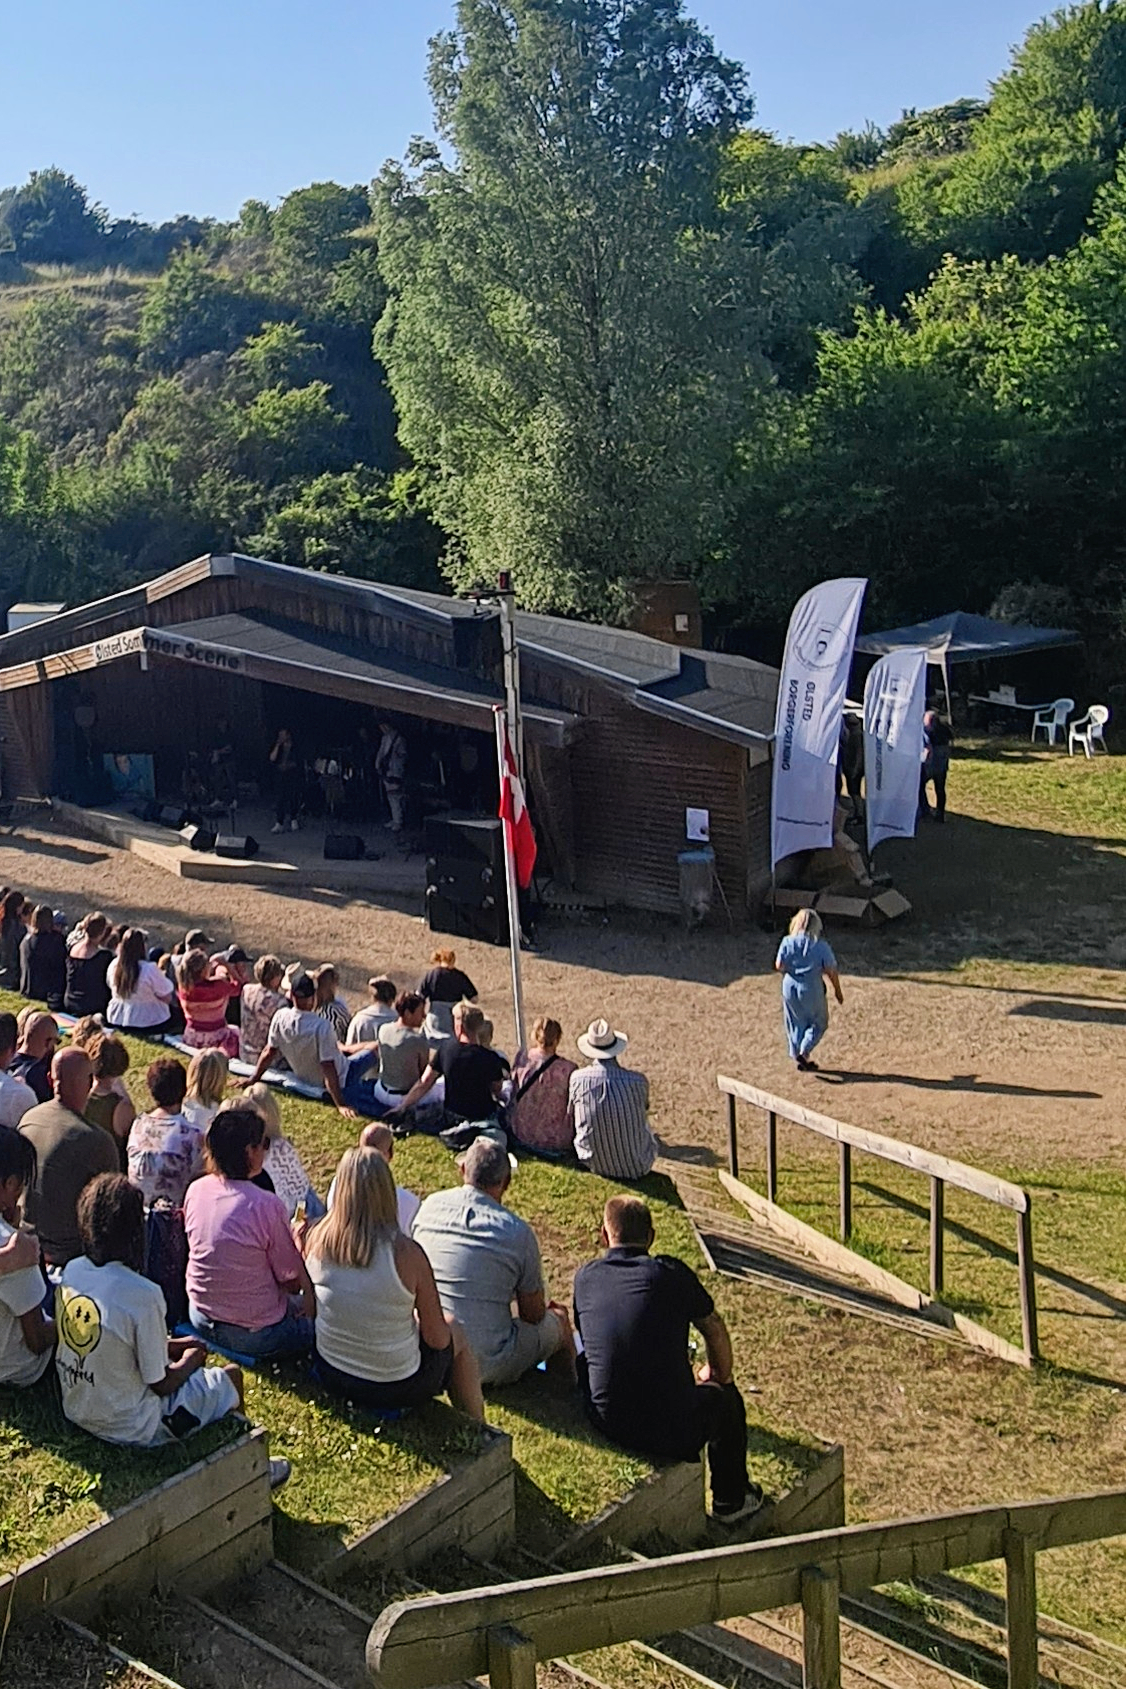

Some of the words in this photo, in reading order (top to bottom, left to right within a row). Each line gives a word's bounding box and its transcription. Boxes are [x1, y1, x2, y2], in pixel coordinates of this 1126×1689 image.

[96, 638, 122, 660] Ølsted
[184, 642, 240, 669] Scene
[803, 681, 815, 721] ØLSTED
